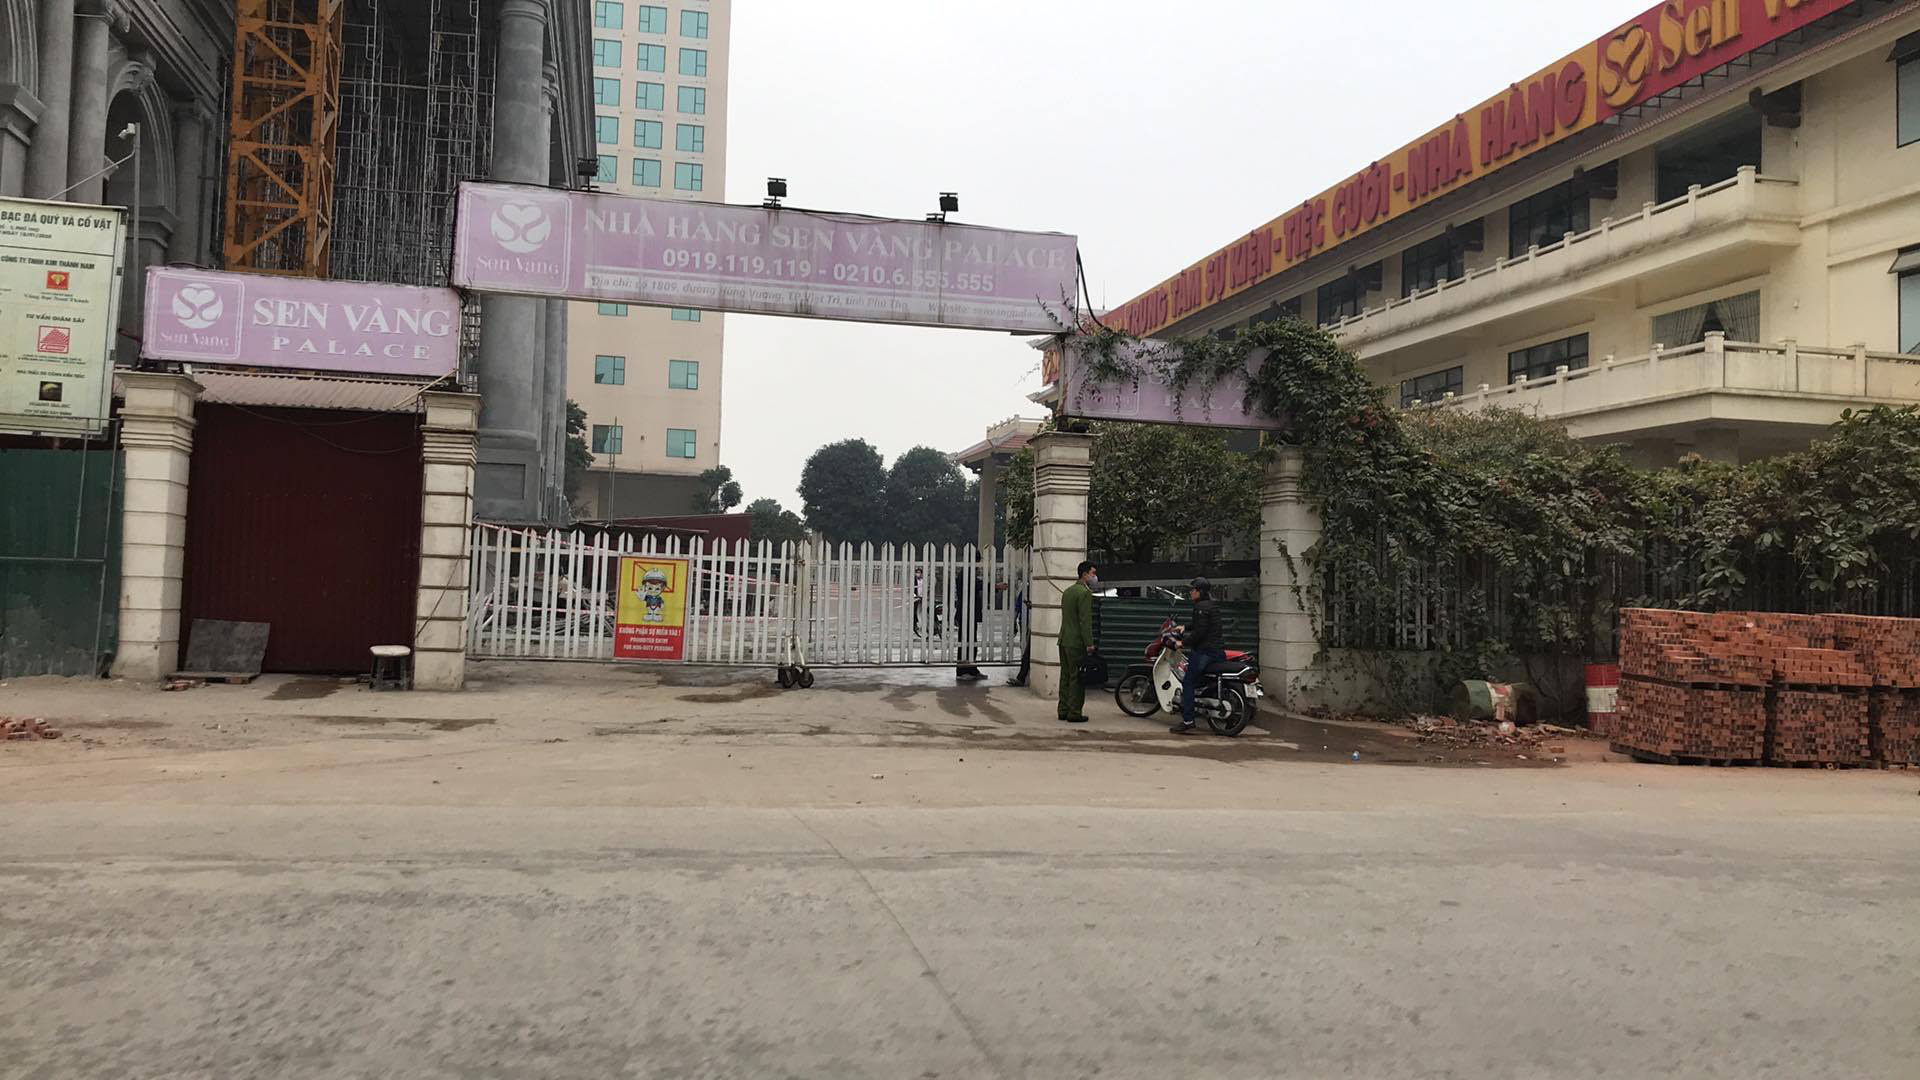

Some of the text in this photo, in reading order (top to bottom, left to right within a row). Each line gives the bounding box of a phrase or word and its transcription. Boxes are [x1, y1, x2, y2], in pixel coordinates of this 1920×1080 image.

[1284, 200, 1326, 262] TIỆC
[1407, 113, 1473, 202] NHÀ
[1479, 61, 1587, 166] HÀNG
[1, 211, 112, 231] BẠC ĐÁ QUÝ VÀ CỔ VẬT
[584, 207, 1066, 271] NHÀ HÀNG SEN VÀNG PALACE
[662, 248, 811, 279] 0919.119.119
[833, 262, 995, 293] 0210.6.555.555
[253, 298, 450, 337] SEN VÀNG
[273, 336, 431, 360] PALACE
